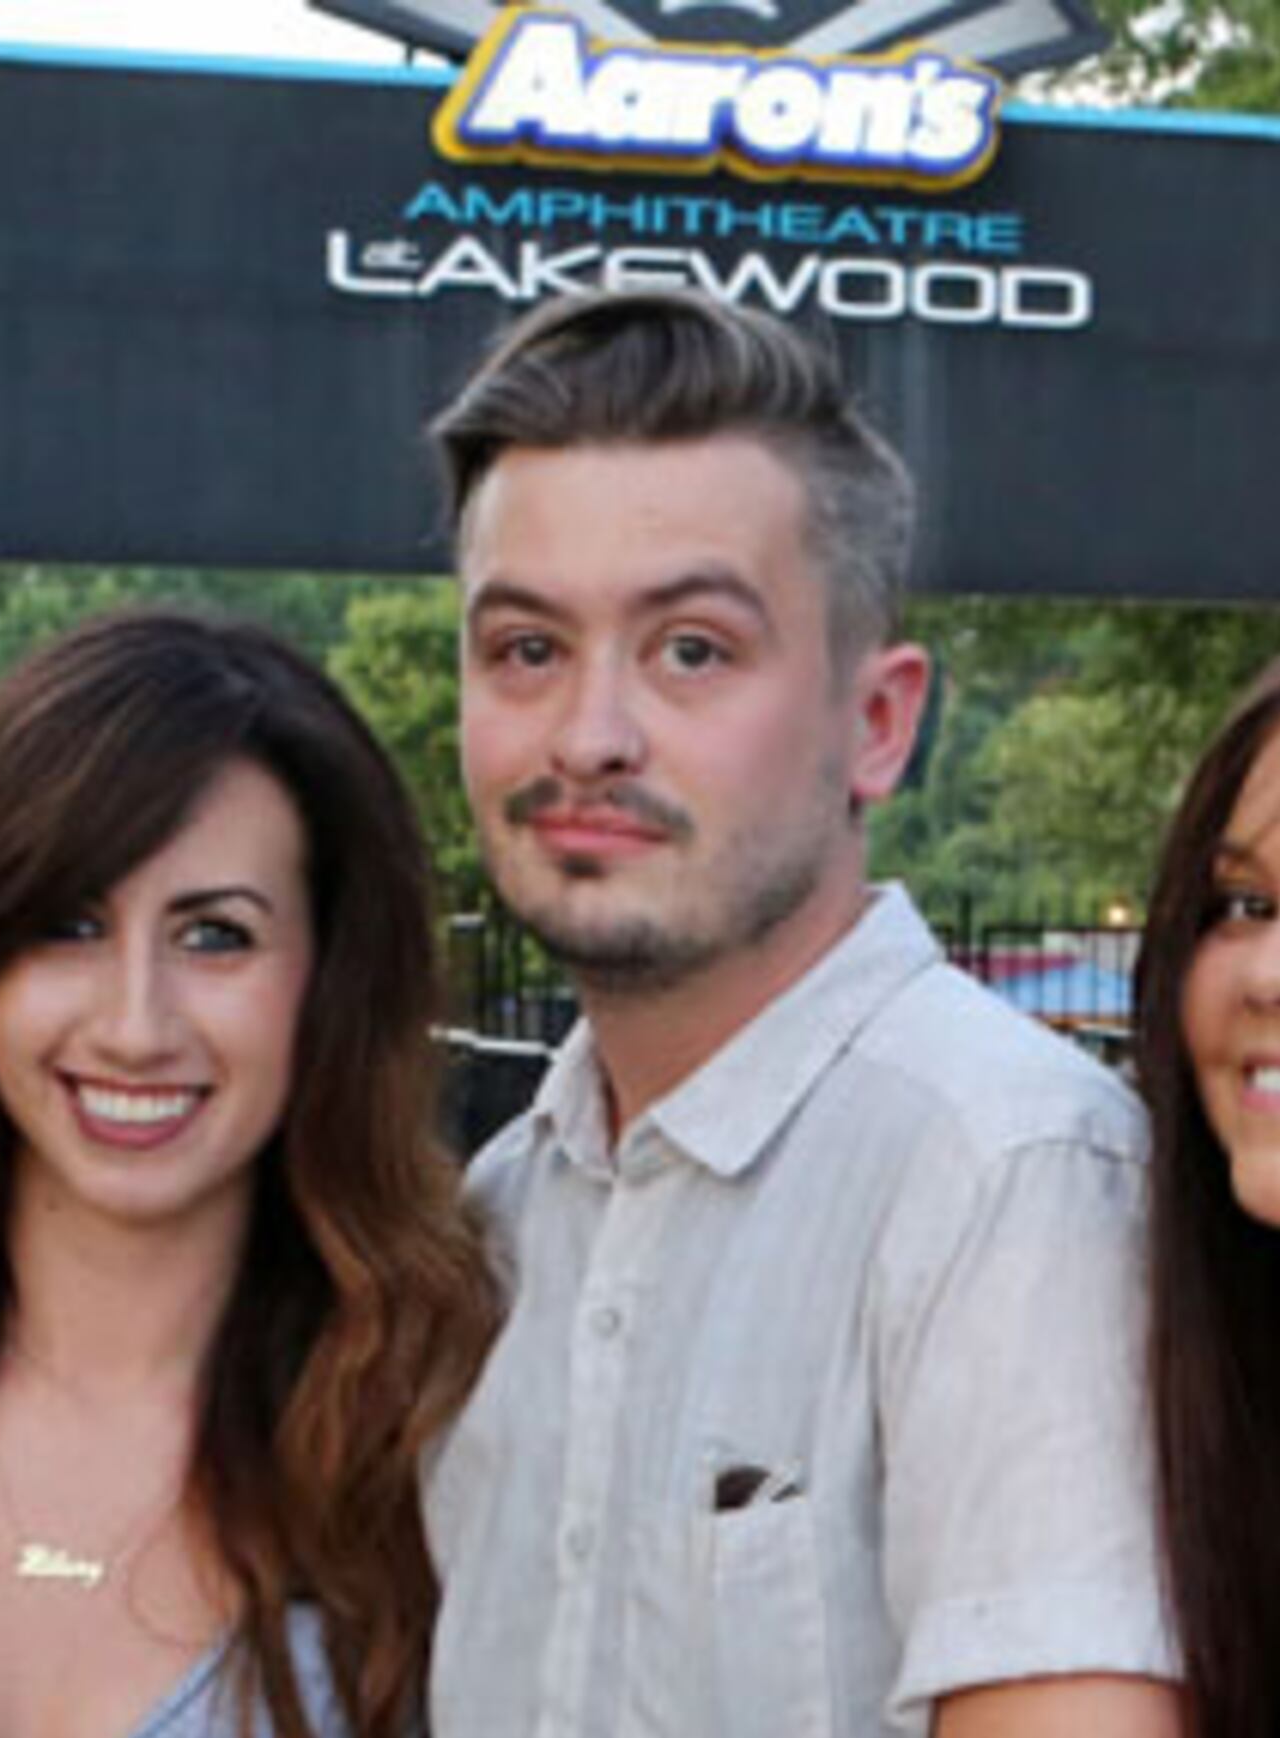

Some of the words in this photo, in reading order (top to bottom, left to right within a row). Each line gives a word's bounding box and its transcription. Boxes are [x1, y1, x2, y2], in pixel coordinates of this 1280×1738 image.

[458, 14, 996, 170] Aaron's
[403, 181, 1024, 254] AMPHITHEATRE
[326, 229, 1092, 329] LAKEWOOD
